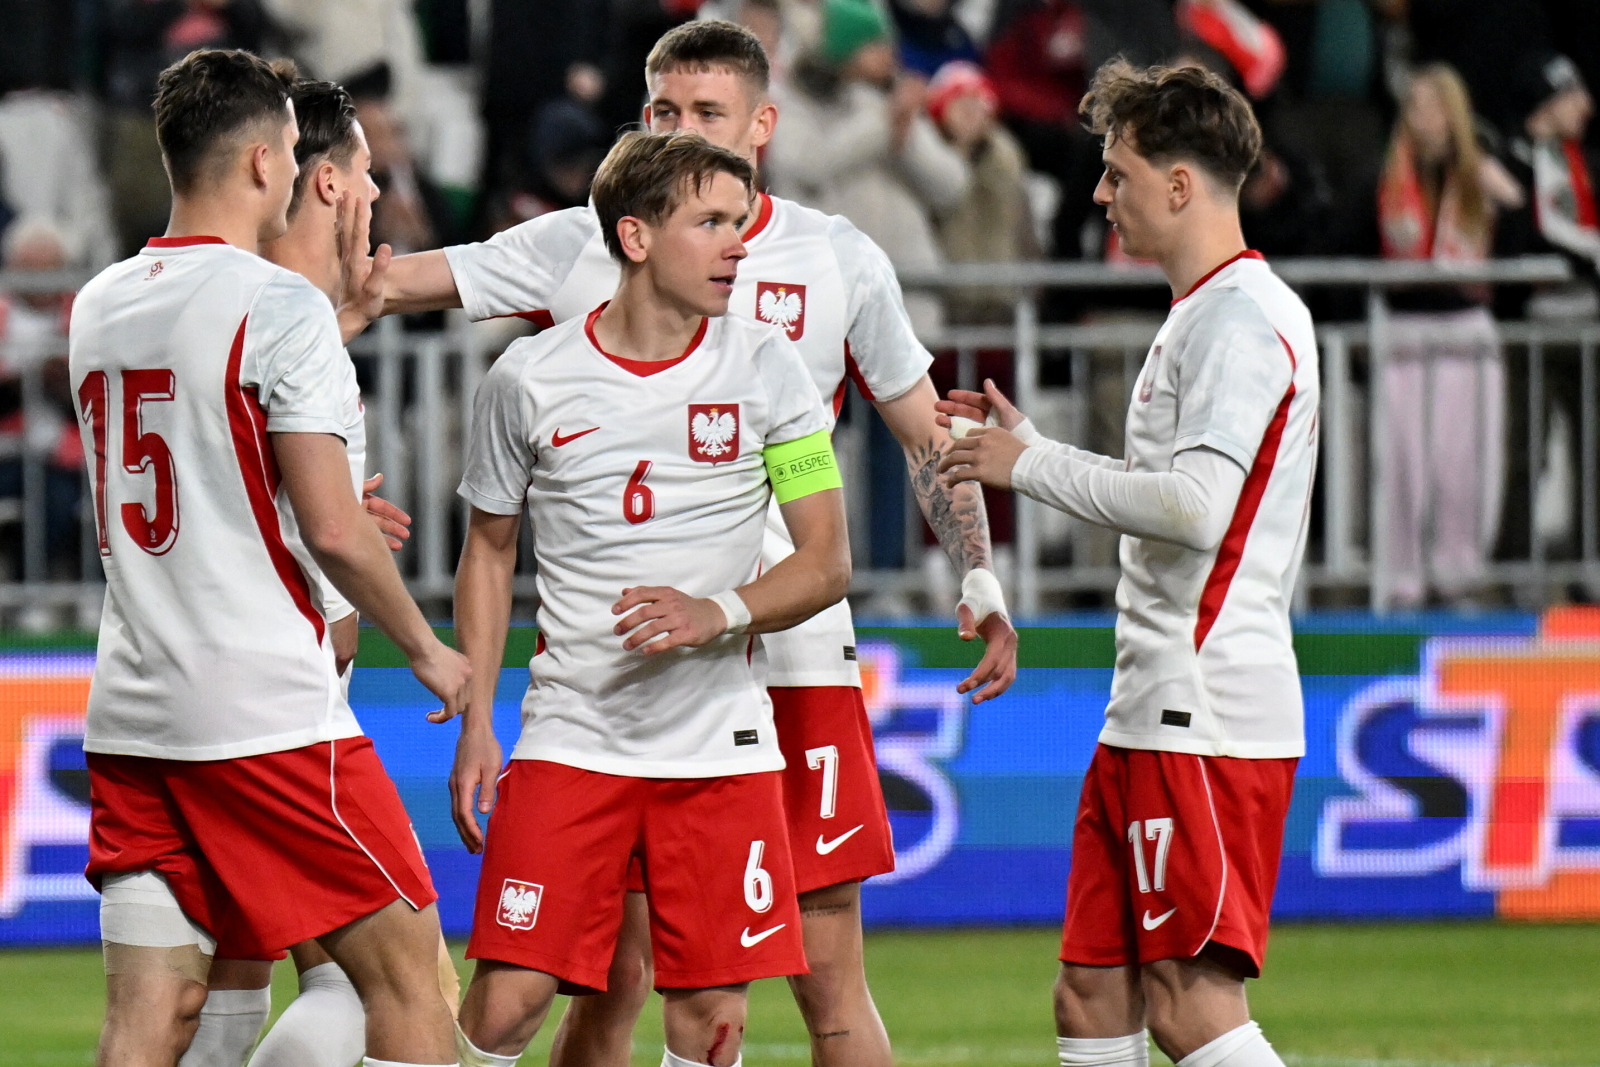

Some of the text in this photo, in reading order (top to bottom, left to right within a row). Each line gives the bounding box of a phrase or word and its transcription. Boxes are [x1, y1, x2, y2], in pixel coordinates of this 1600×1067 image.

[78, 369, 180, 556] 15
[623, 460, 656, 525] 6
[789, 454, 832, 475] RESPECT
[805, 745, 839, 819] 7
[1314, 640, 1600, 886] ST
[743, 840, 774, 913] 6
[1127, 817, 1174, 893] 17
